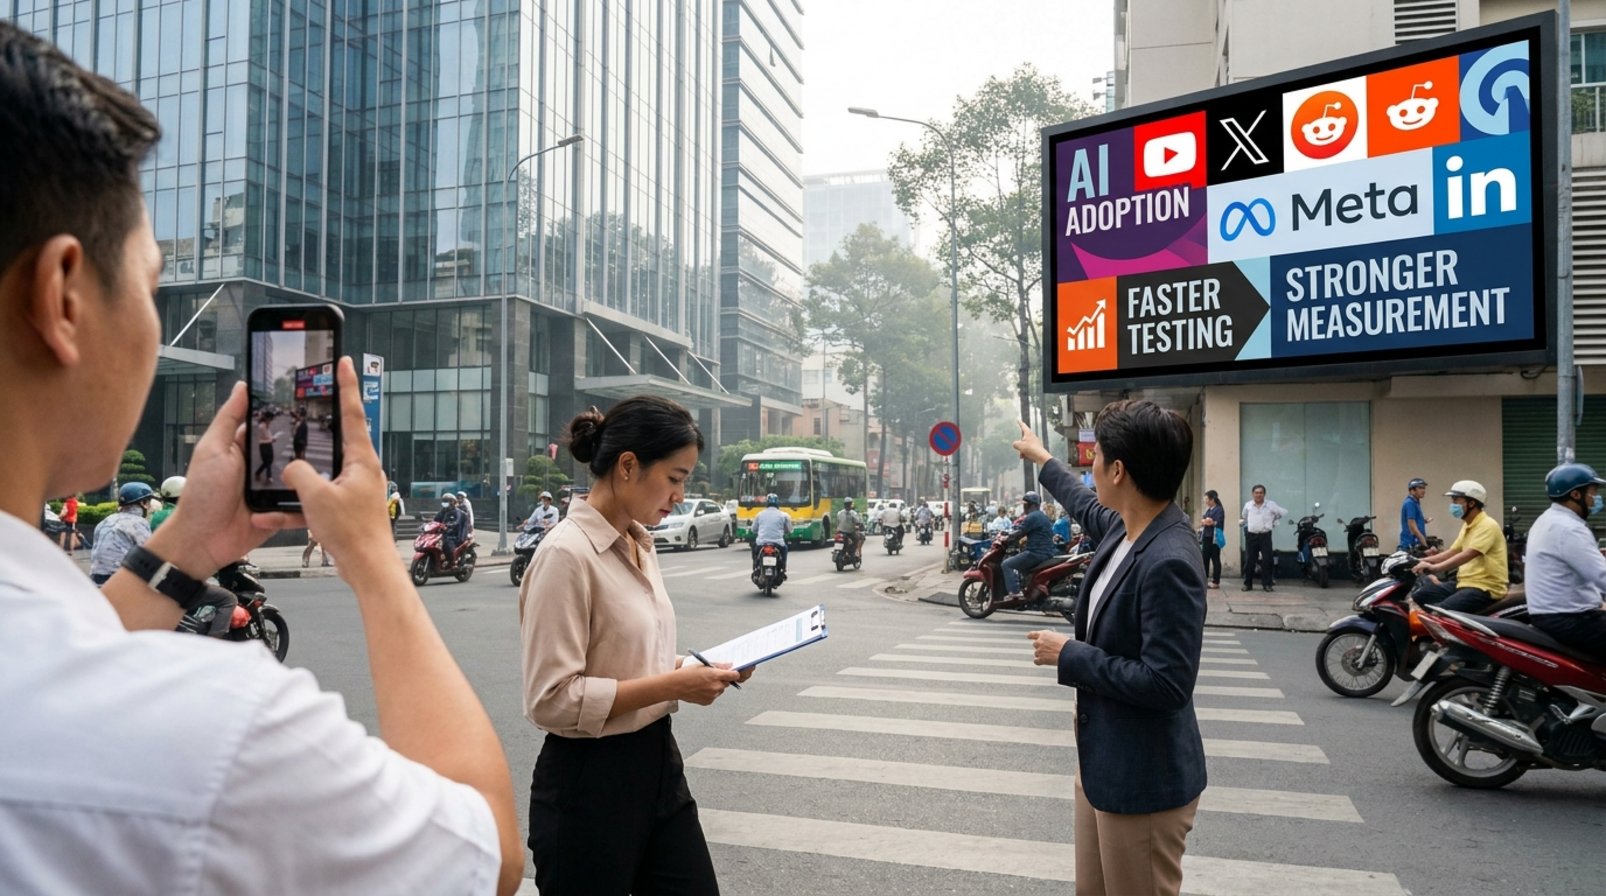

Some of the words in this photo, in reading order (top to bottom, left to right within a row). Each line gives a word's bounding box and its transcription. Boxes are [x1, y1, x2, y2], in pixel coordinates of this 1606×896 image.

[1067, 144, 1109, 202] AI
[1447, 155, 1517, 219] in
[1065, 187, 1190, 236] ADOPTION
[1292, 181, 1418, 231] Meta
[1127, 278, 1221, 319] FASTER
[1286, 250, 1458, 302] STRONGER
[1127, 315, 1233, 355] TESTING
[1287, 287, 1510, 342] MEASUREMENT
